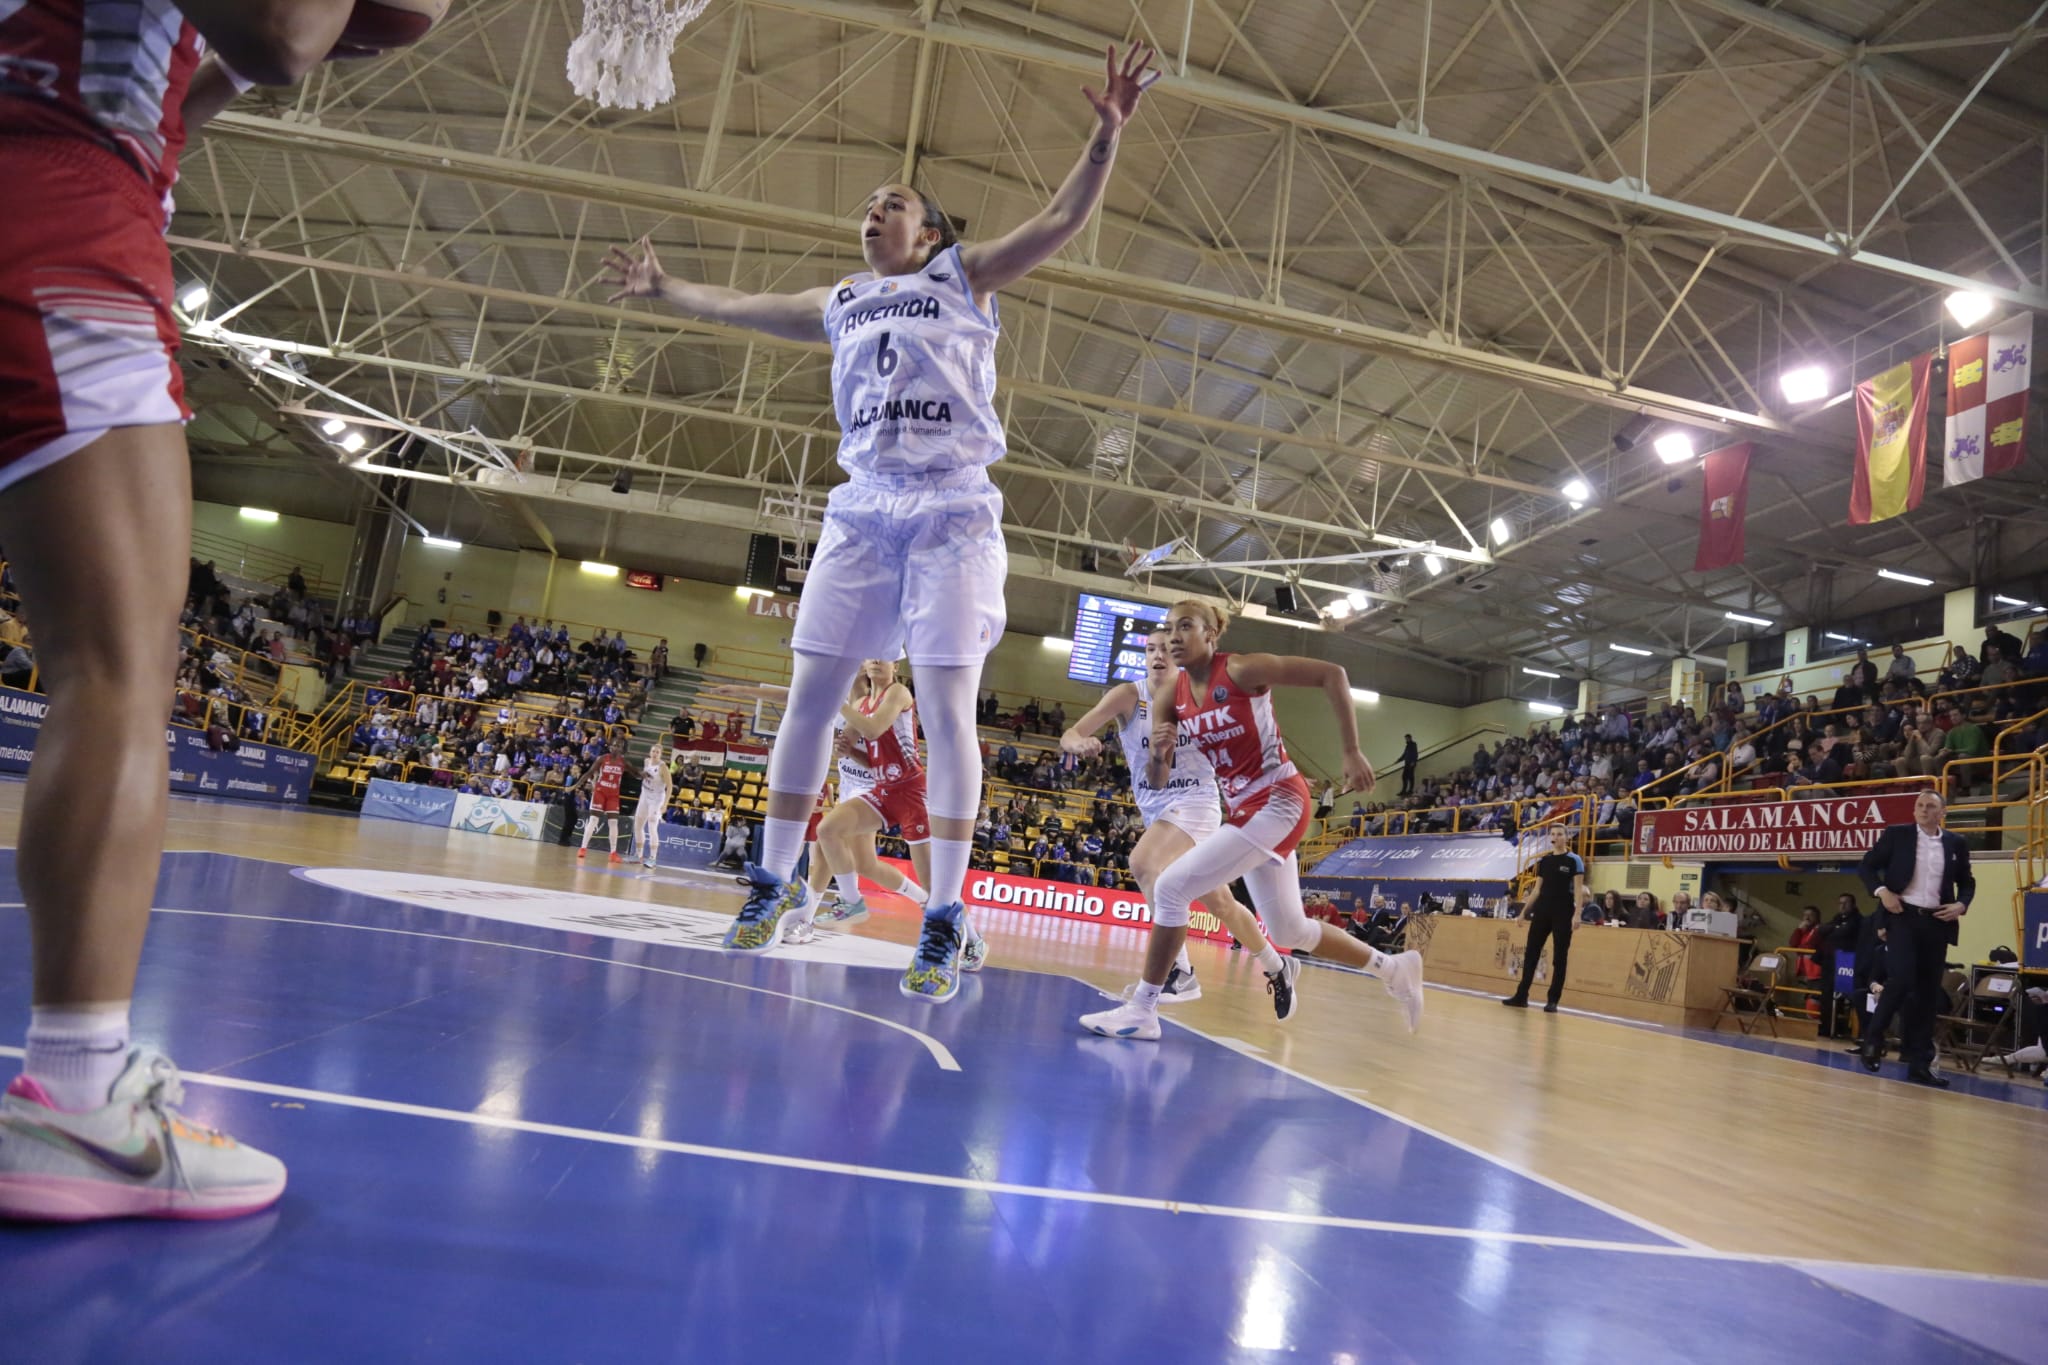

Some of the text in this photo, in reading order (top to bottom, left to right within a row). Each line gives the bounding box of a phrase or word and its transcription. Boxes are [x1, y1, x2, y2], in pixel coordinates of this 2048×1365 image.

[876, 331, 898, 378] 6
[1122, 617, 1135, 632] 5
[1119, 667, 1127, 679] 1
[1139, 778, 1200, 791] SAANCA
[371, 791, 450, 812] MAYBELLINE
[1684, 799, 1886, 833] SALAMANCA
[1657, 833, 1745, 853] PATRIMONIO
[1750, 831, 1772, 851] DE
[1776, 830, 1796, 850] LA
[971, 876, 1104, 916] dominio
